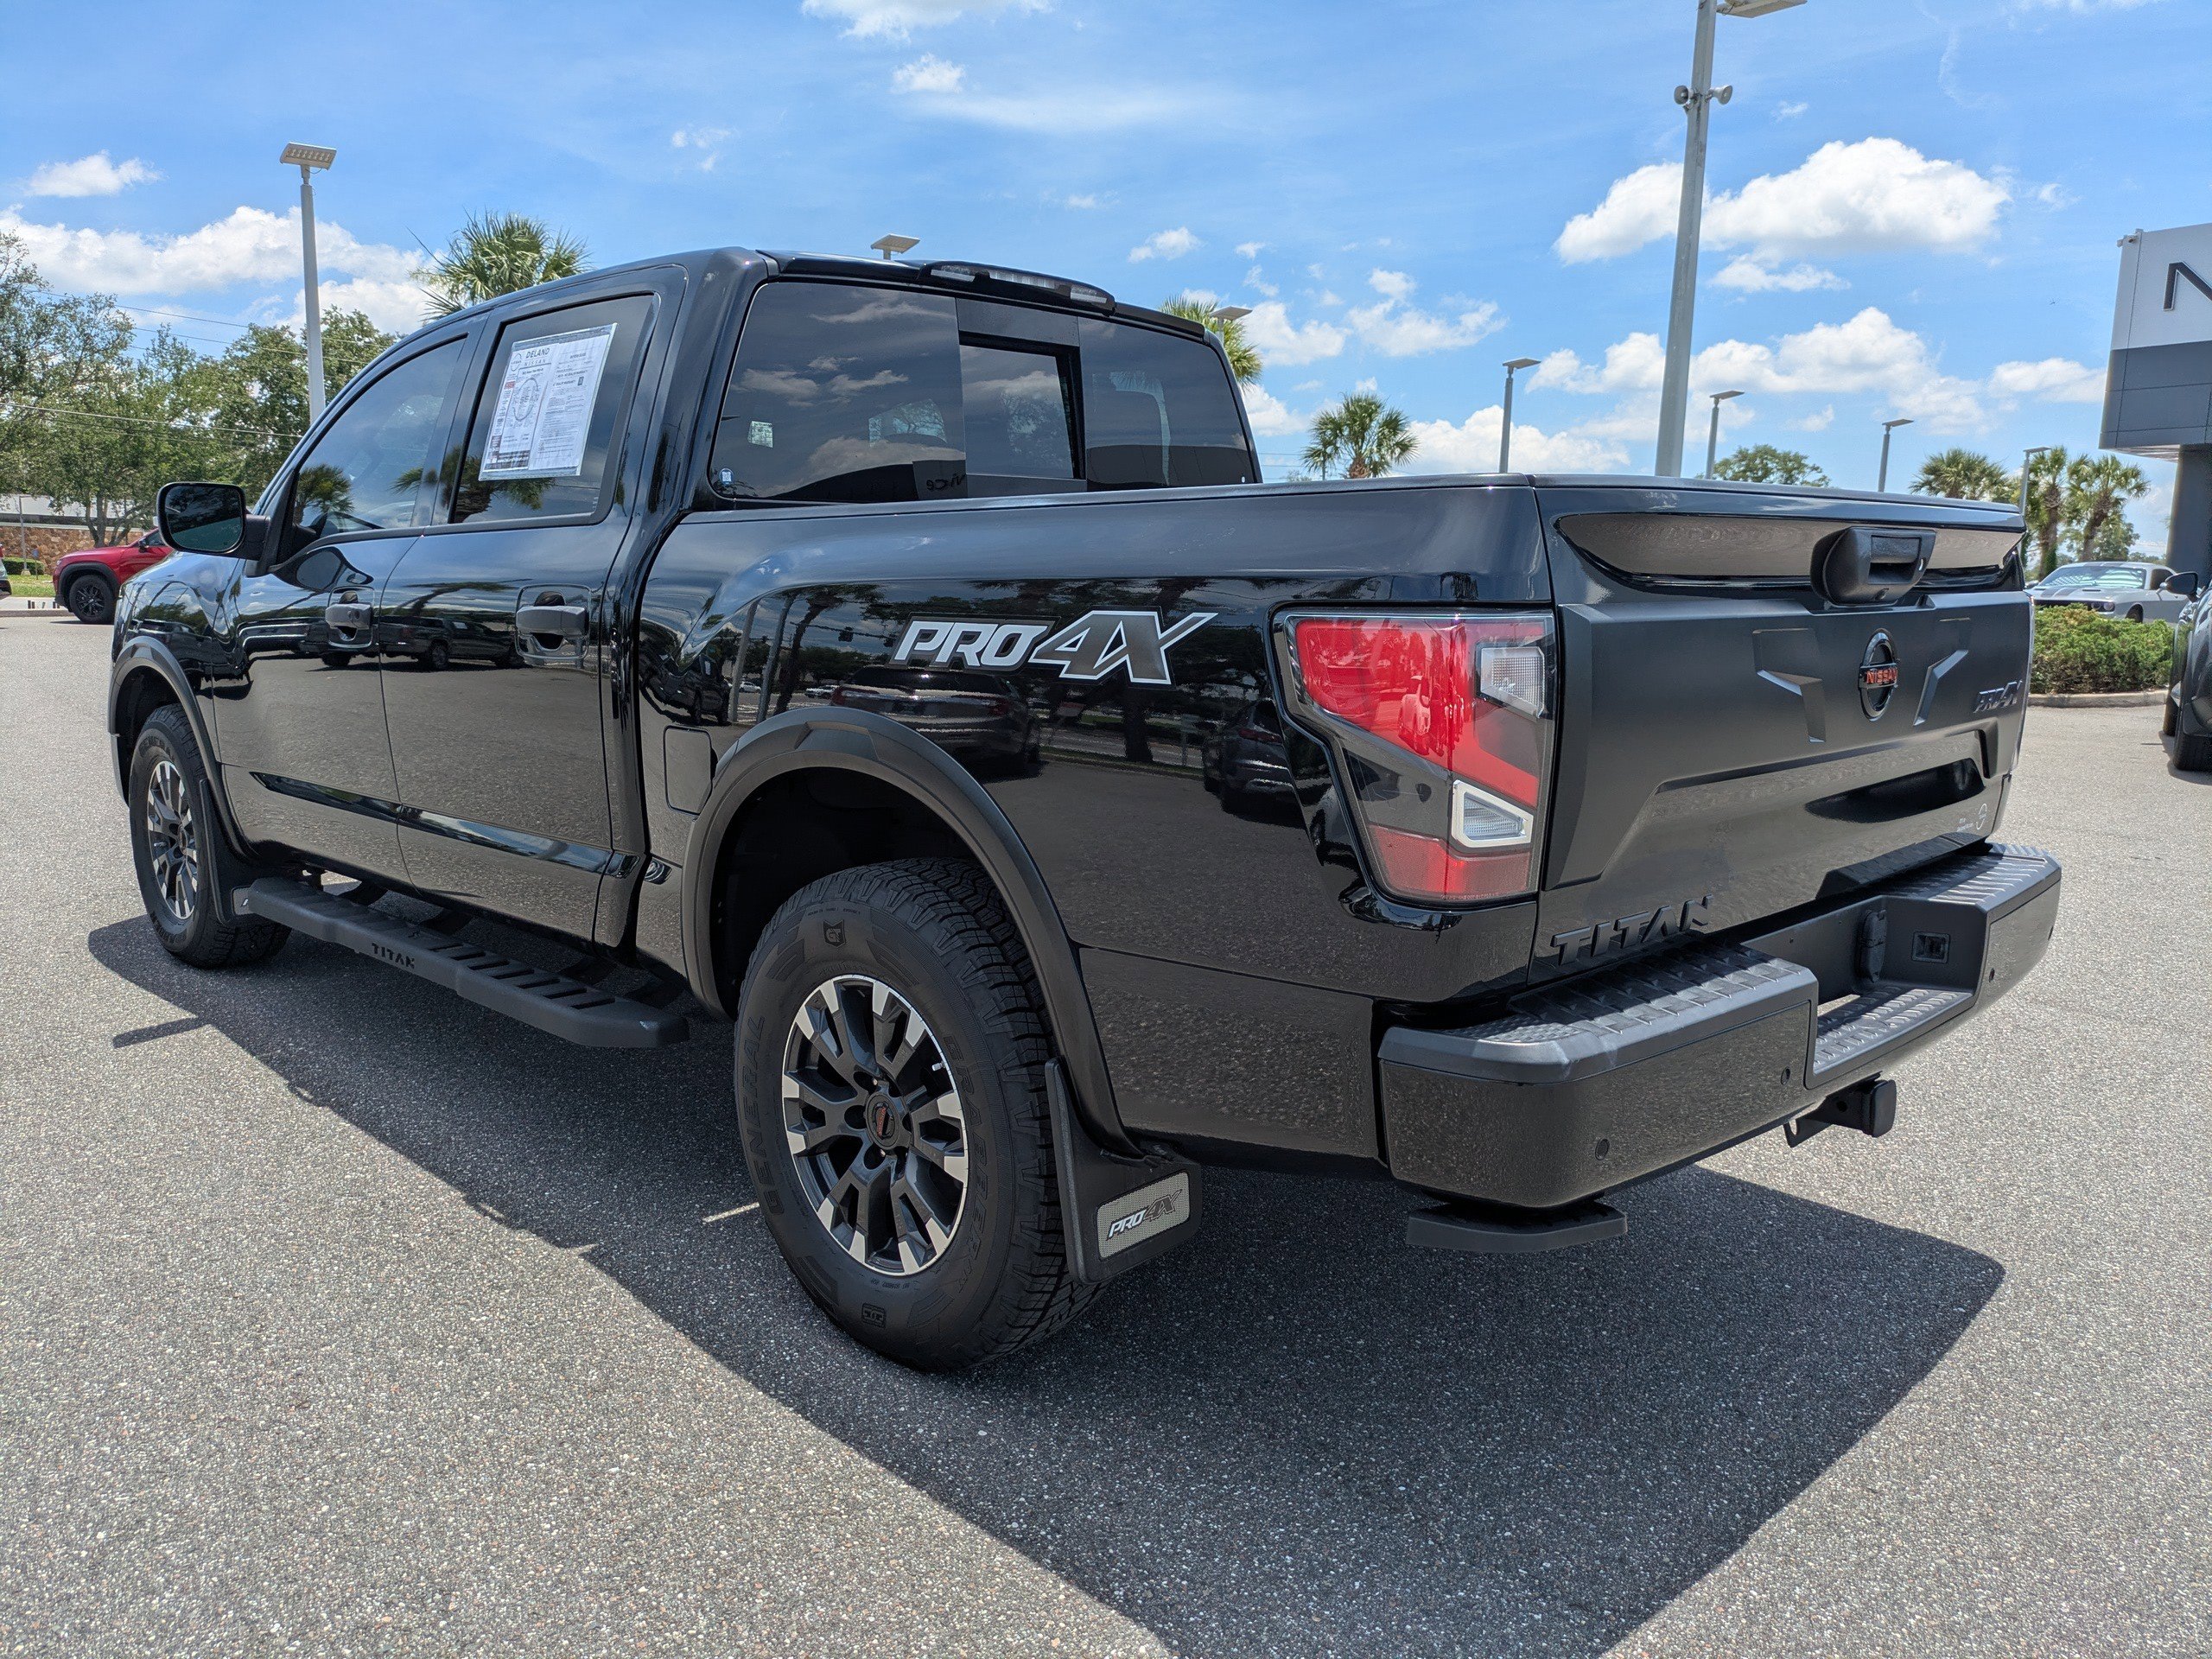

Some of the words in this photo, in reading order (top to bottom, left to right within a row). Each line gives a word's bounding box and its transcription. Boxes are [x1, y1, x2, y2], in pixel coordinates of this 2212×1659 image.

[525, 347, 550, 359] DELAND
[1866, 666, 1898, 684] NISSAN
[1549, 893, 1713, 967] TITAN
[372, 942, 416, 969] TITAN
[738, 1016, 785, 1217] GENERAL
